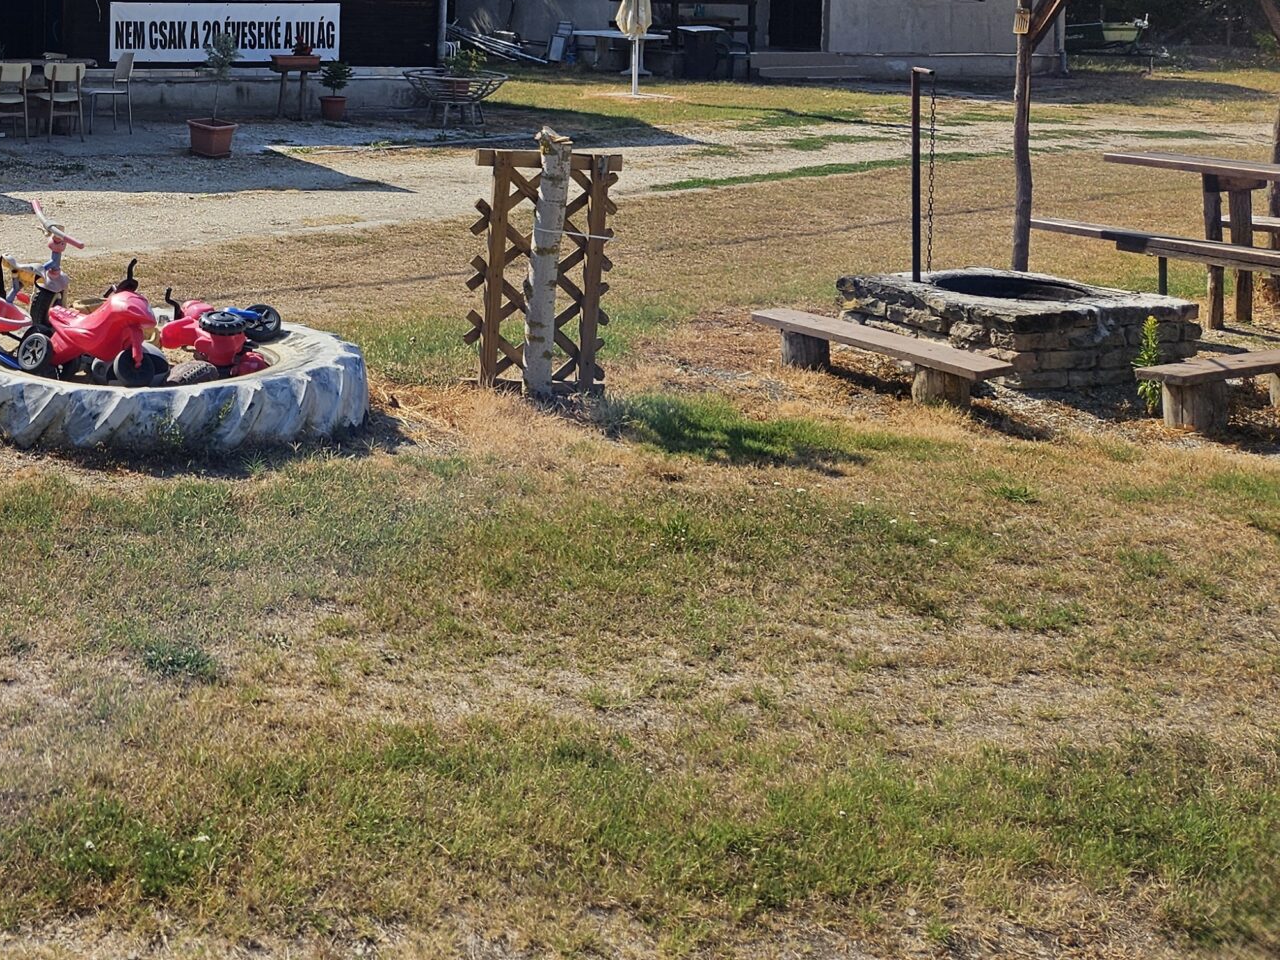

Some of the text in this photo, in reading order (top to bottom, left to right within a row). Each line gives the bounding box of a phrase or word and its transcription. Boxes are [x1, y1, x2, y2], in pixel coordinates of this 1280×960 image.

[115, 21, 145, 50] NEM
[149, 20, 187, 50] CSAK
[190, 21, 199, 49] A
[224, 16, 281, 49] ÉVESEKÉ
[284, 22, 293, 49] A
[296, 16, 335, 49] VILÁG
